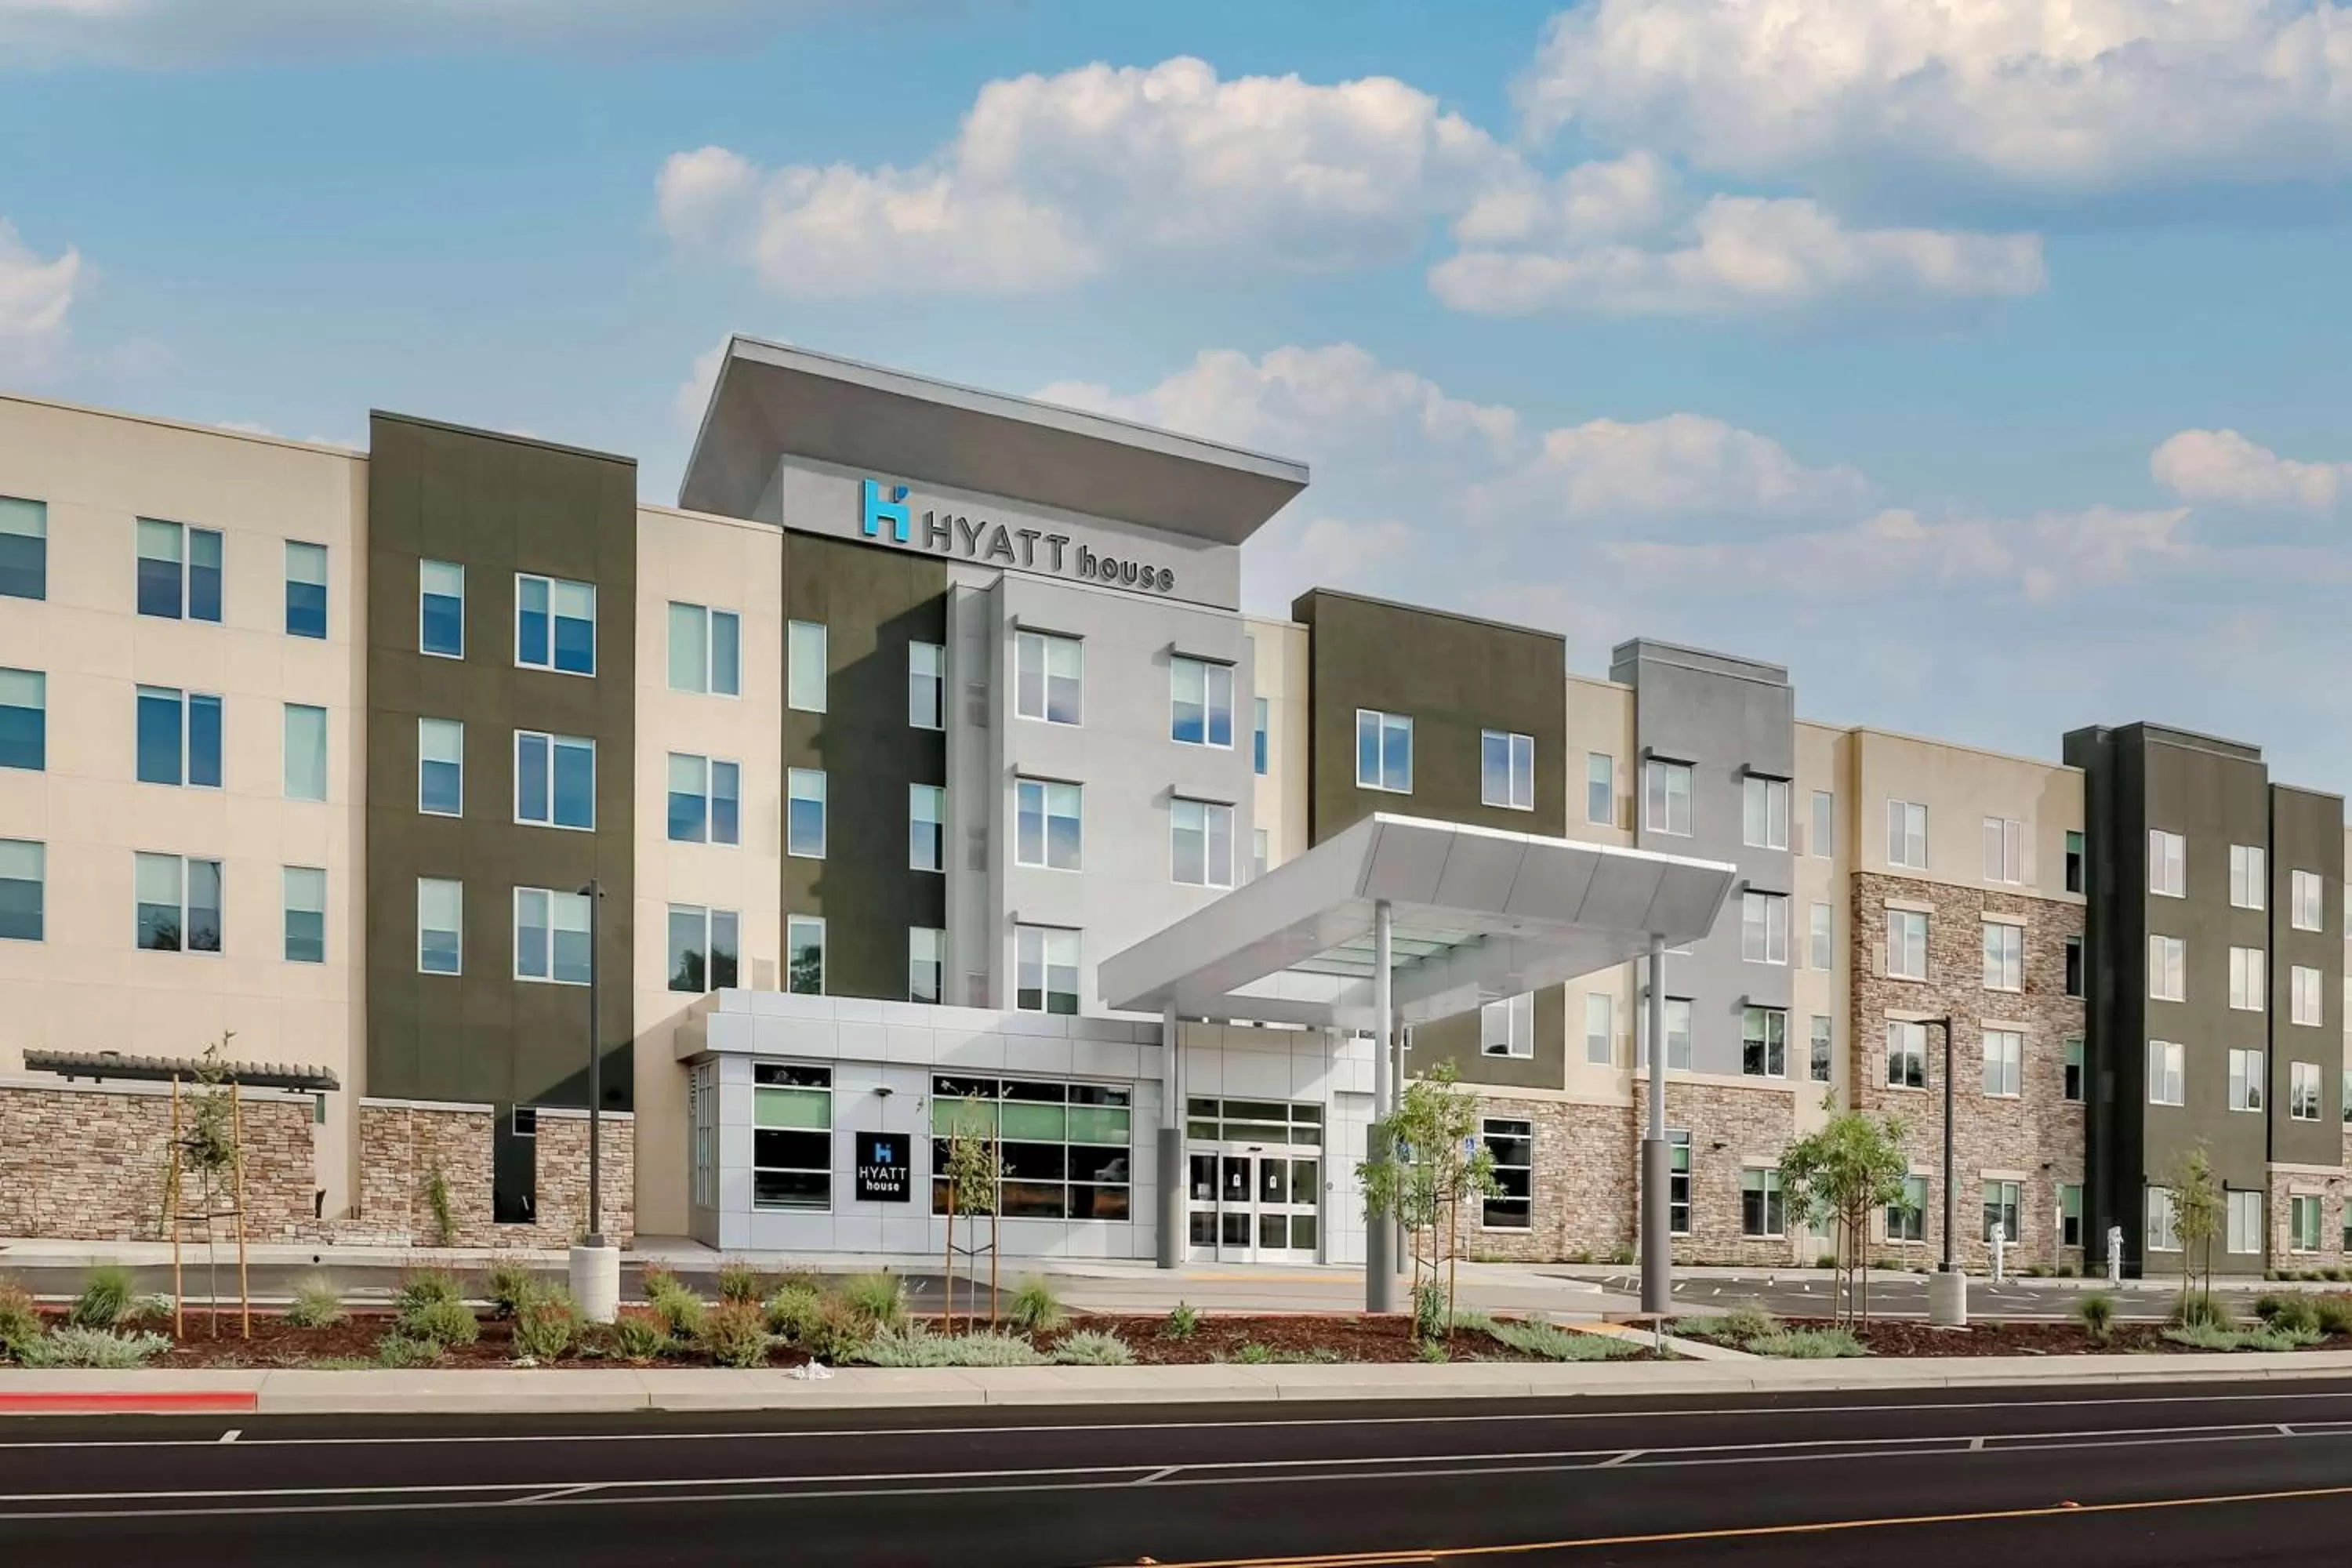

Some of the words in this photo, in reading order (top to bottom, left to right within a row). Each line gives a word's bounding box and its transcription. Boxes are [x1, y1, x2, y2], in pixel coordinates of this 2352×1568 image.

[923, 510, 1070, 571] HYATT
[1078, 544, 1175, 592] house
[858, 1166, 907, 1180] HYATT
[866, 1179, 900, 1192] house
